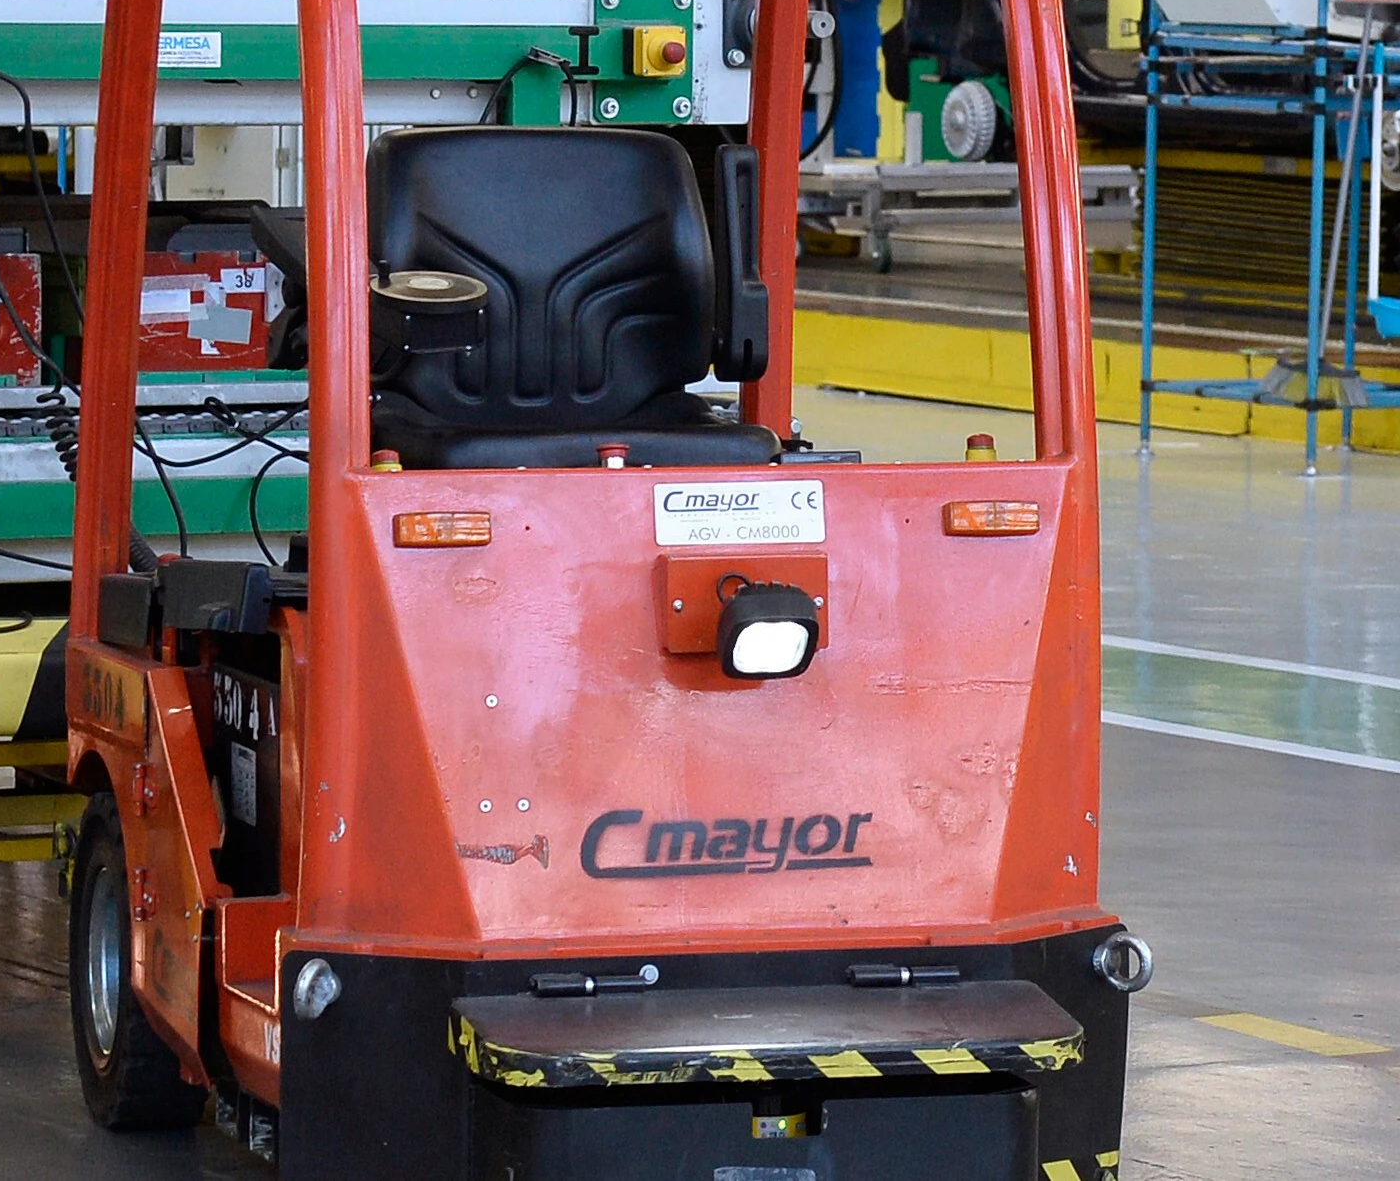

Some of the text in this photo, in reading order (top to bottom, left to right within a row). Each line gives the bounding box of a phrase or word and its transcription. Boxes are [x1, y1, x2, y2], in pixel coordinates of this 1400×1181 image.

[663, 490, 761, 512] Cmayor
[688, 527, 722, 541] AGV
[736, 524, 801, 540] CM8000
[580, 809, 874, 879] Cmayor
